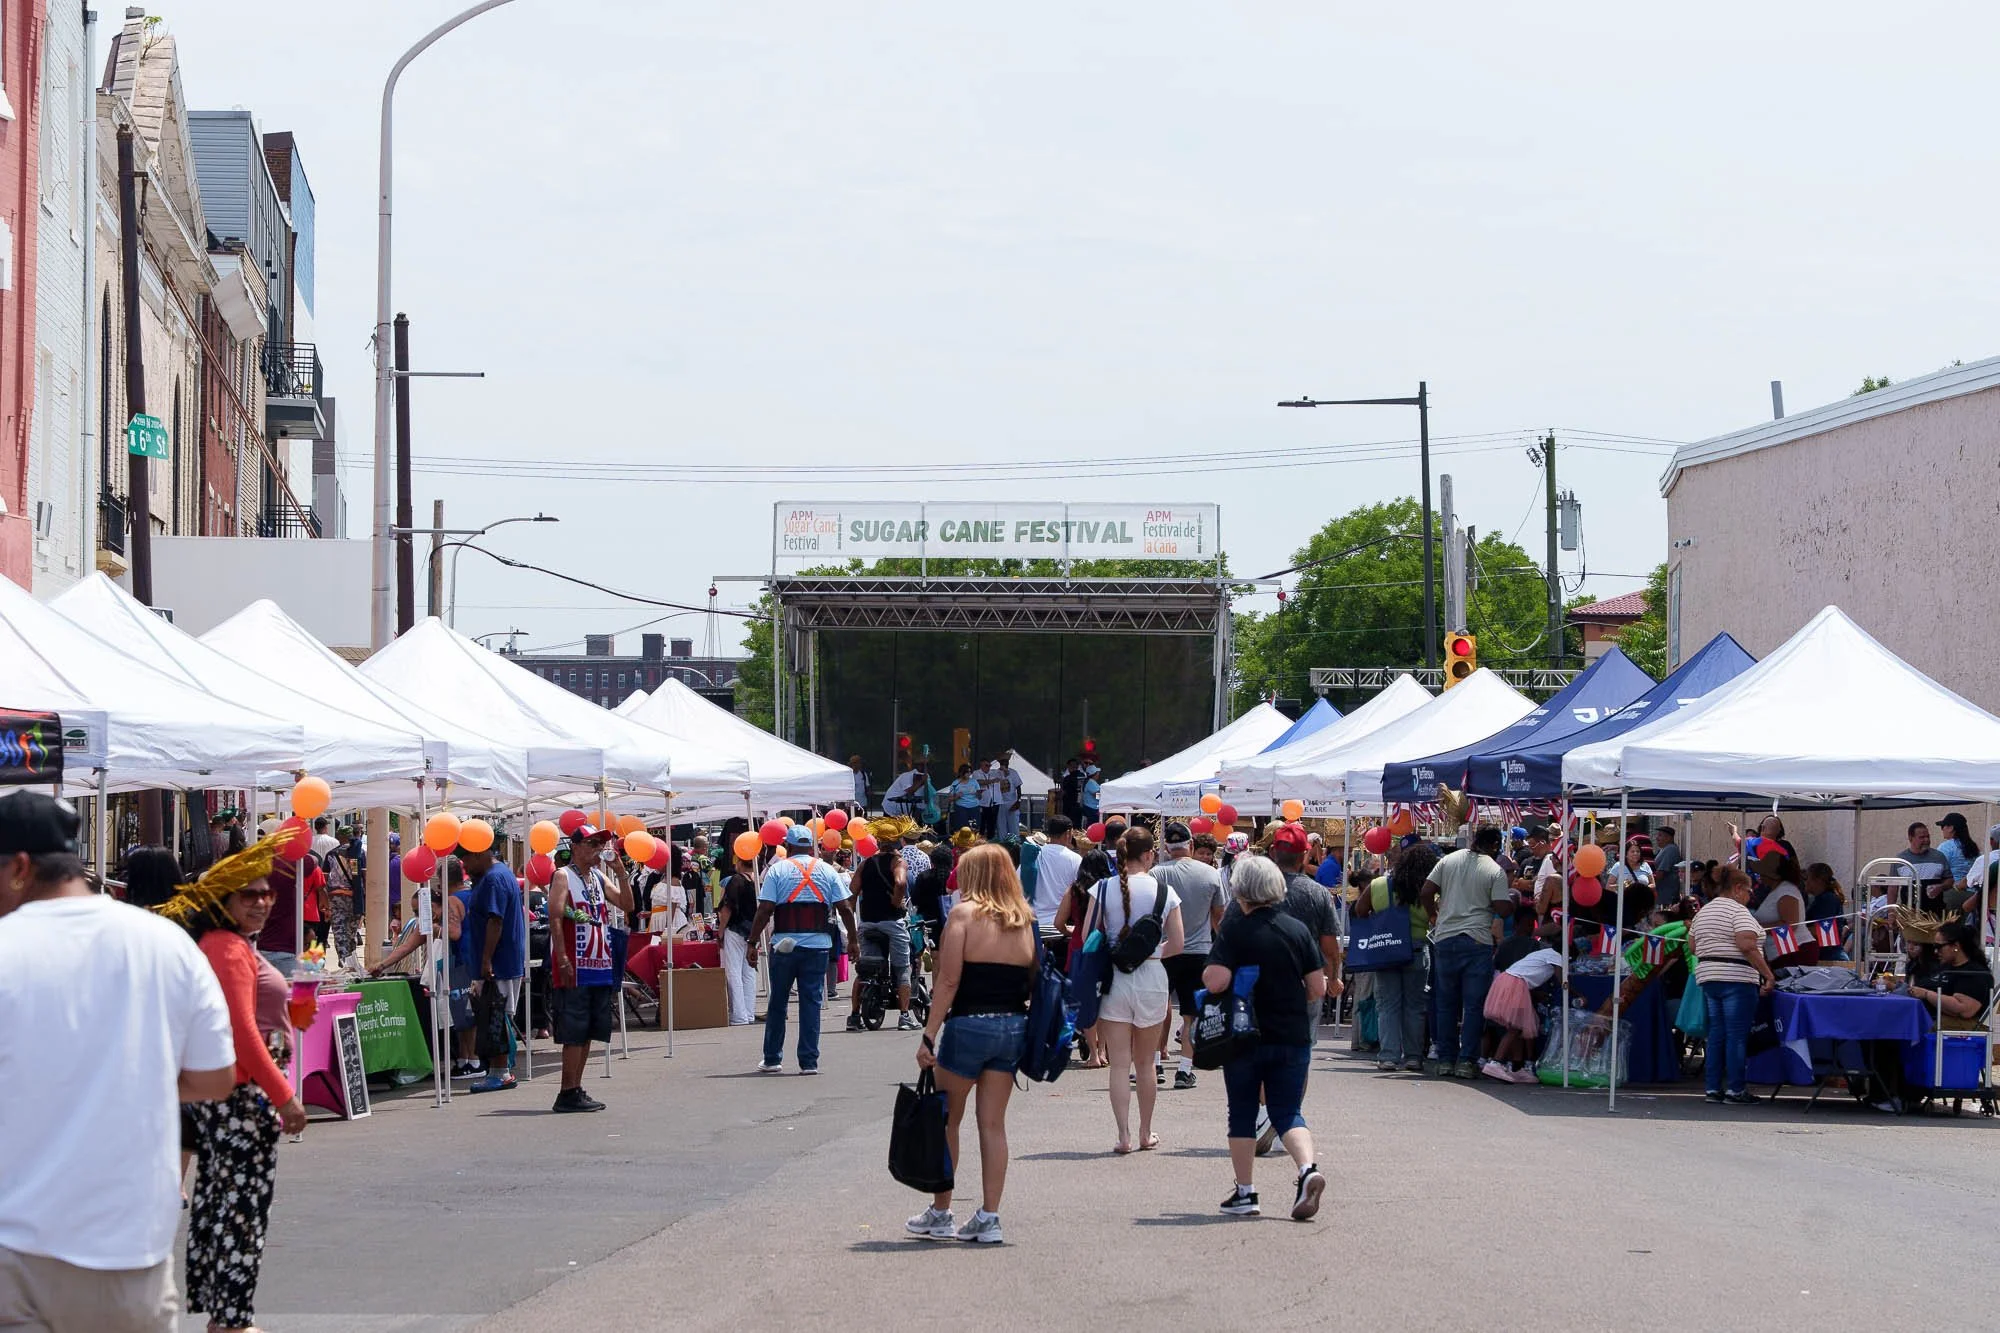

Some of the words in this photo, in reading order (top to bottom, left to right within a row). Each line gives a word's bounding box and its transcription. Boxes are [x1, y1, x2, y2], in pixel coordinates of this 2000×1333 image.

[139, 429, 151, 451] 6th
[156, 435, 166, 455] St
[790, 511, 814, 521] APM
[1146, 511, 1172, 522] APM
[784, 517, 810, 536] Sugar
[813, 518, 837, 533] Cane
[849, 520, 930, 542] SUGAR
[940, 520, 1006, 542] CANE
[1014, 521, 1134, 544] FESTIVAL
[1143, 520, 1182, 537] Festival
[1184, 520, 1195, 537] de
[783, 534, 820, 550] Festival
[1143, 537, 1152, 553] la
